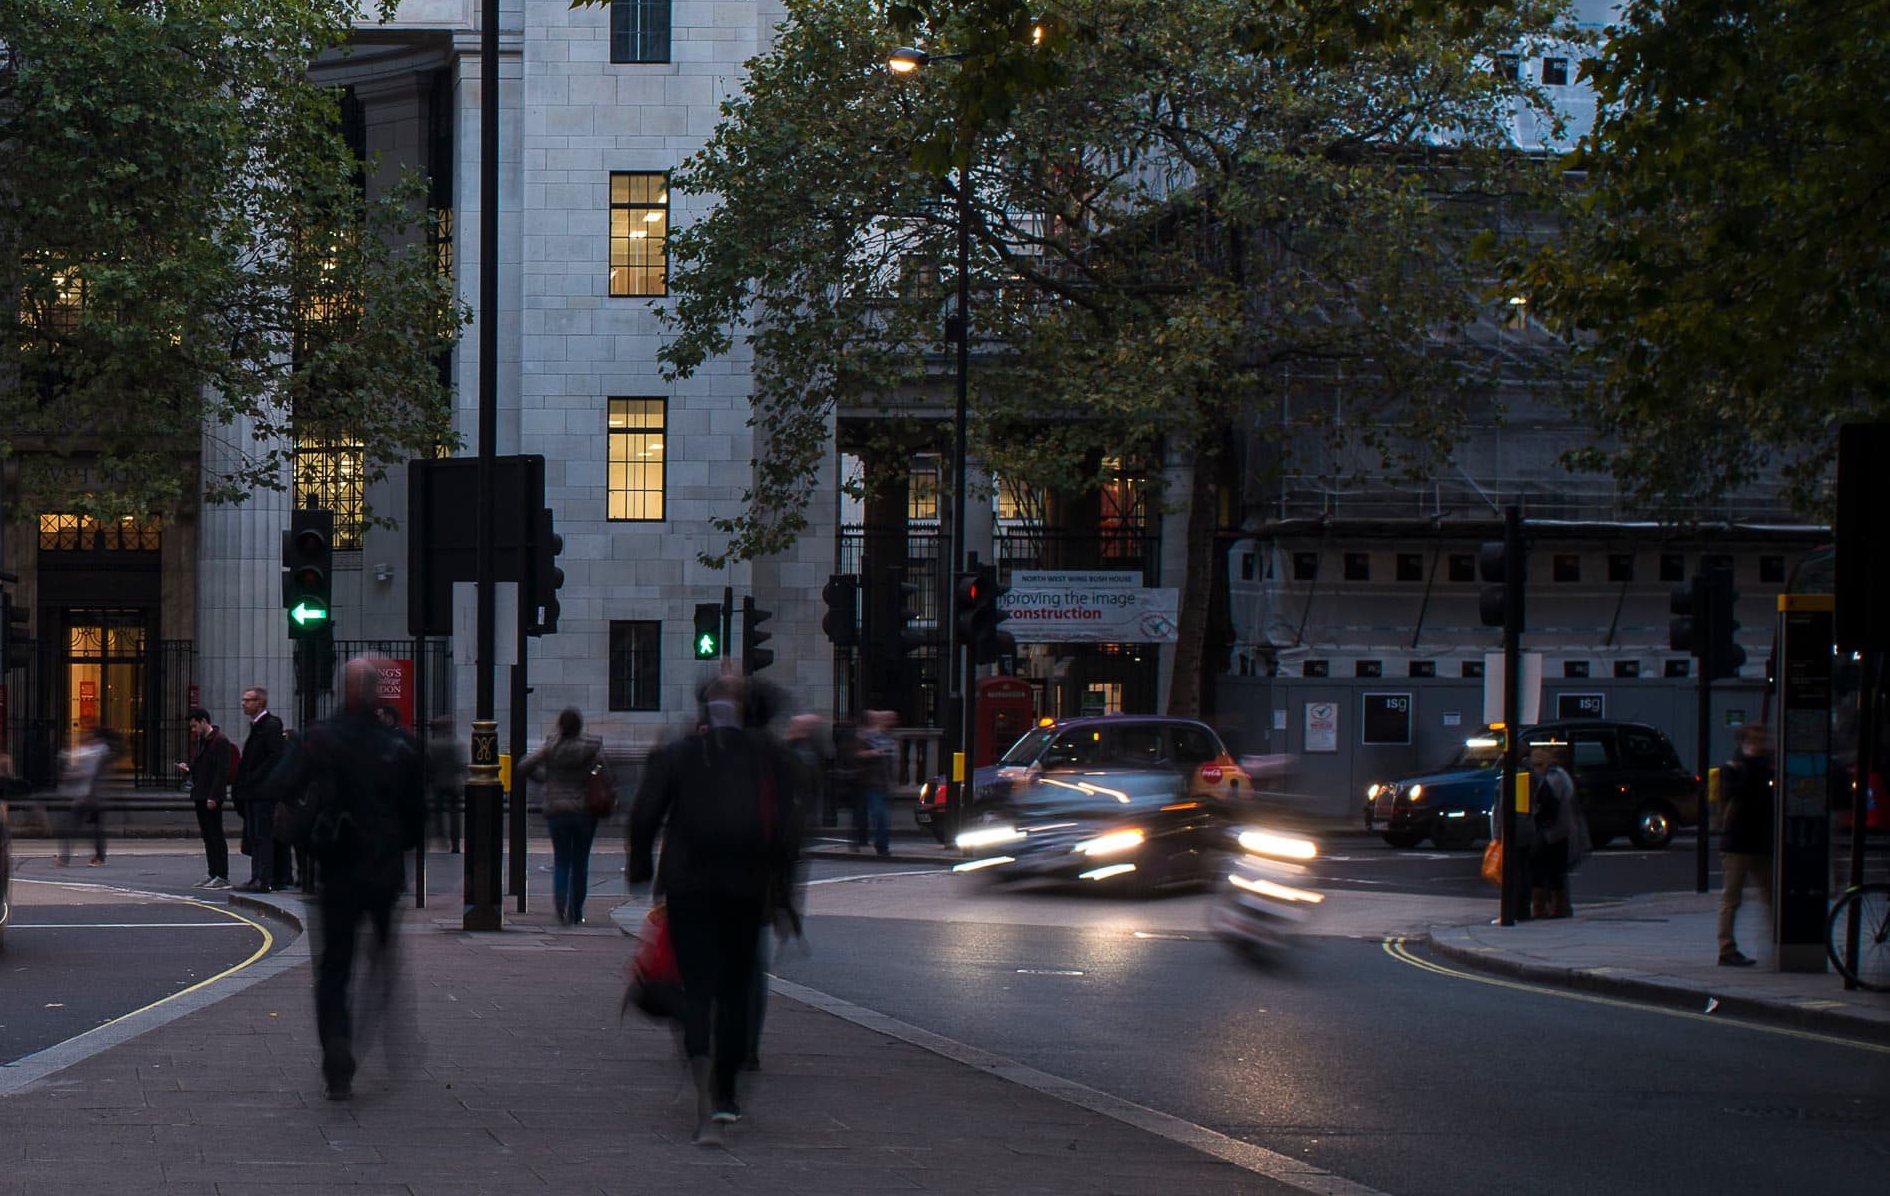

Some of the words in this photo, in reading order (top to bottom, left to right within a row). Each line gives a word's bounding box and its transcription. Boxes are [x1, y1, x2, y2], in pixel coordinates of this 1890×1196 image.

[1021, 575, 1046, 583] NORTH
[1047, 575, 1066, 583] WEST
[1089, 575, 1108, 583] BUSH
[997, 591, 1060, 607] mproving
[1065, 591, 1088, 605] the
[1092, 592, 1135, 607] image
[1006, 606, 1102, 619] construction
[1386, 697, 1407, 713] isg
[1580, 698, 1600, 713] isg
